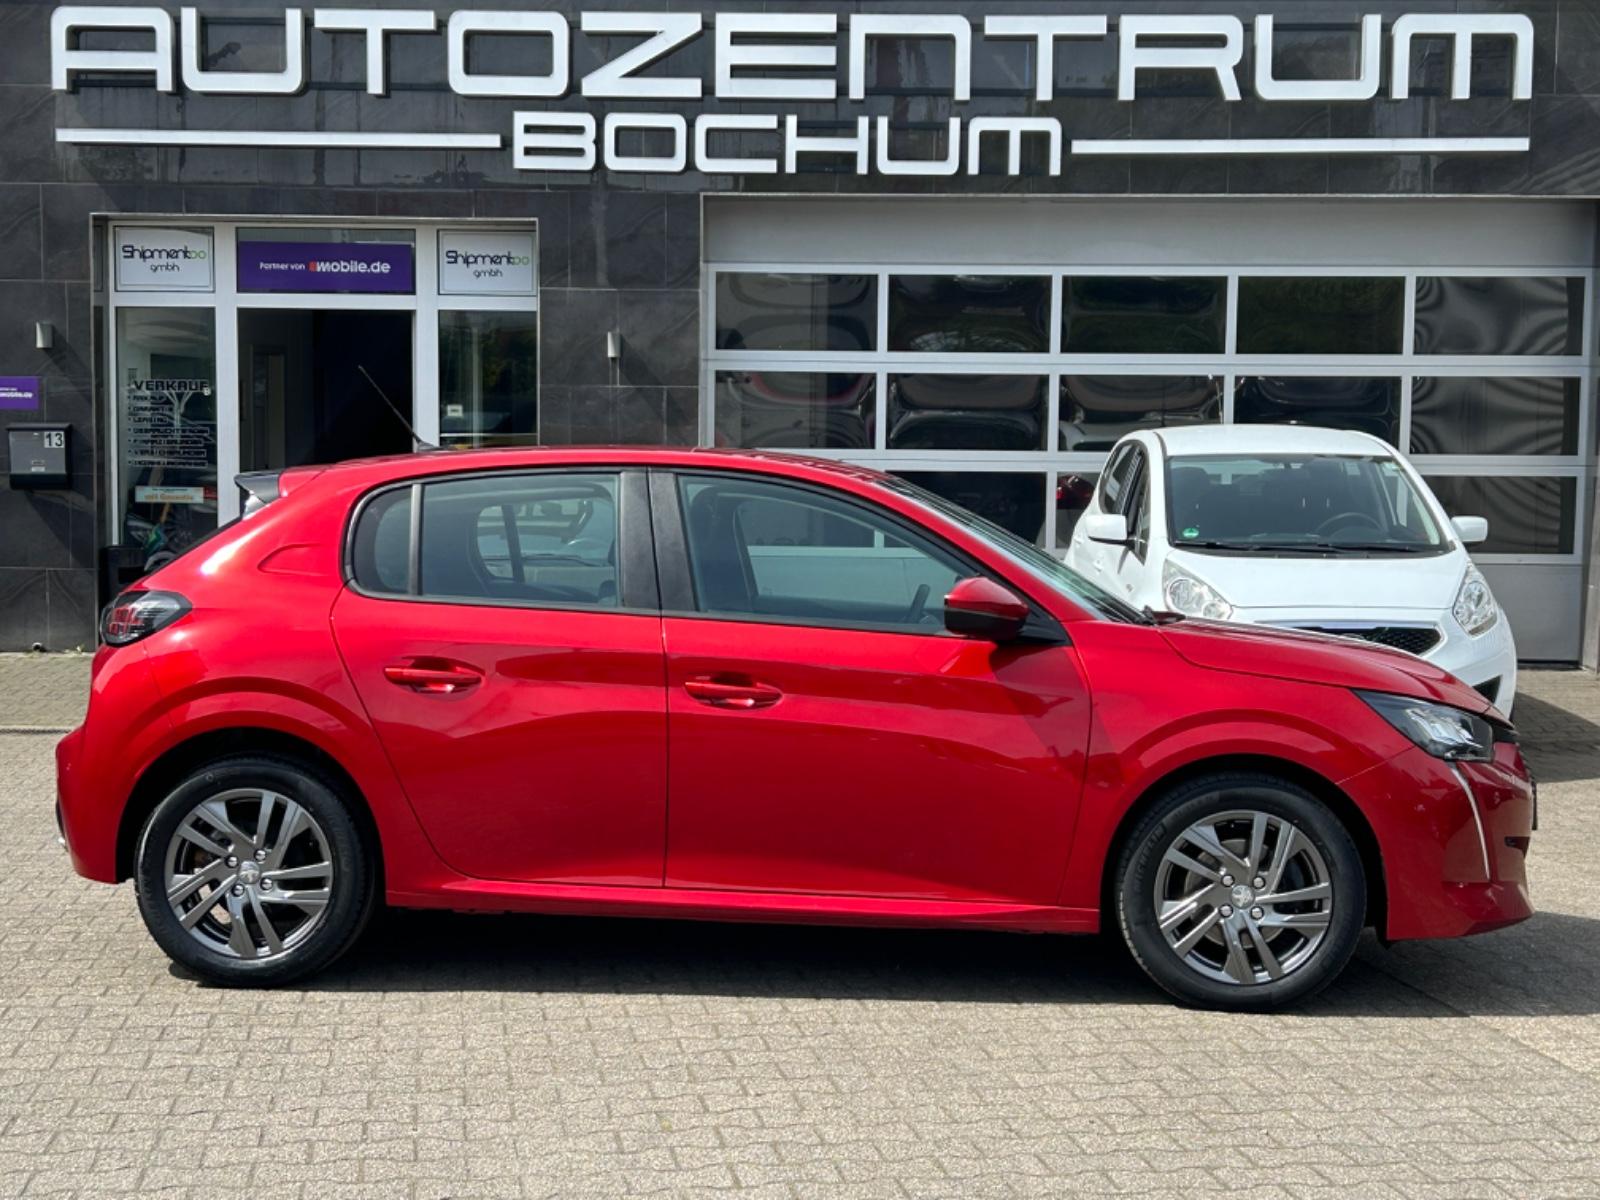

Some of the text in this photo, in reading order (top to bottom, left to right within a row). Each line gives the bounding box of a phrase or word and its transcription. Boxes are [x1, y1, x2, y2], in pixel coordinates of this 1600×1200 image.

[50, 6, 1534, 102] AUTOZENTRUM
[512, 110, 1062, 176] BOCHUM
[259, 260, 392, 274] Partner von mobile.de
[134, 380, 208, 391] VERKAUF
[45, 432, 63, 447] 13
